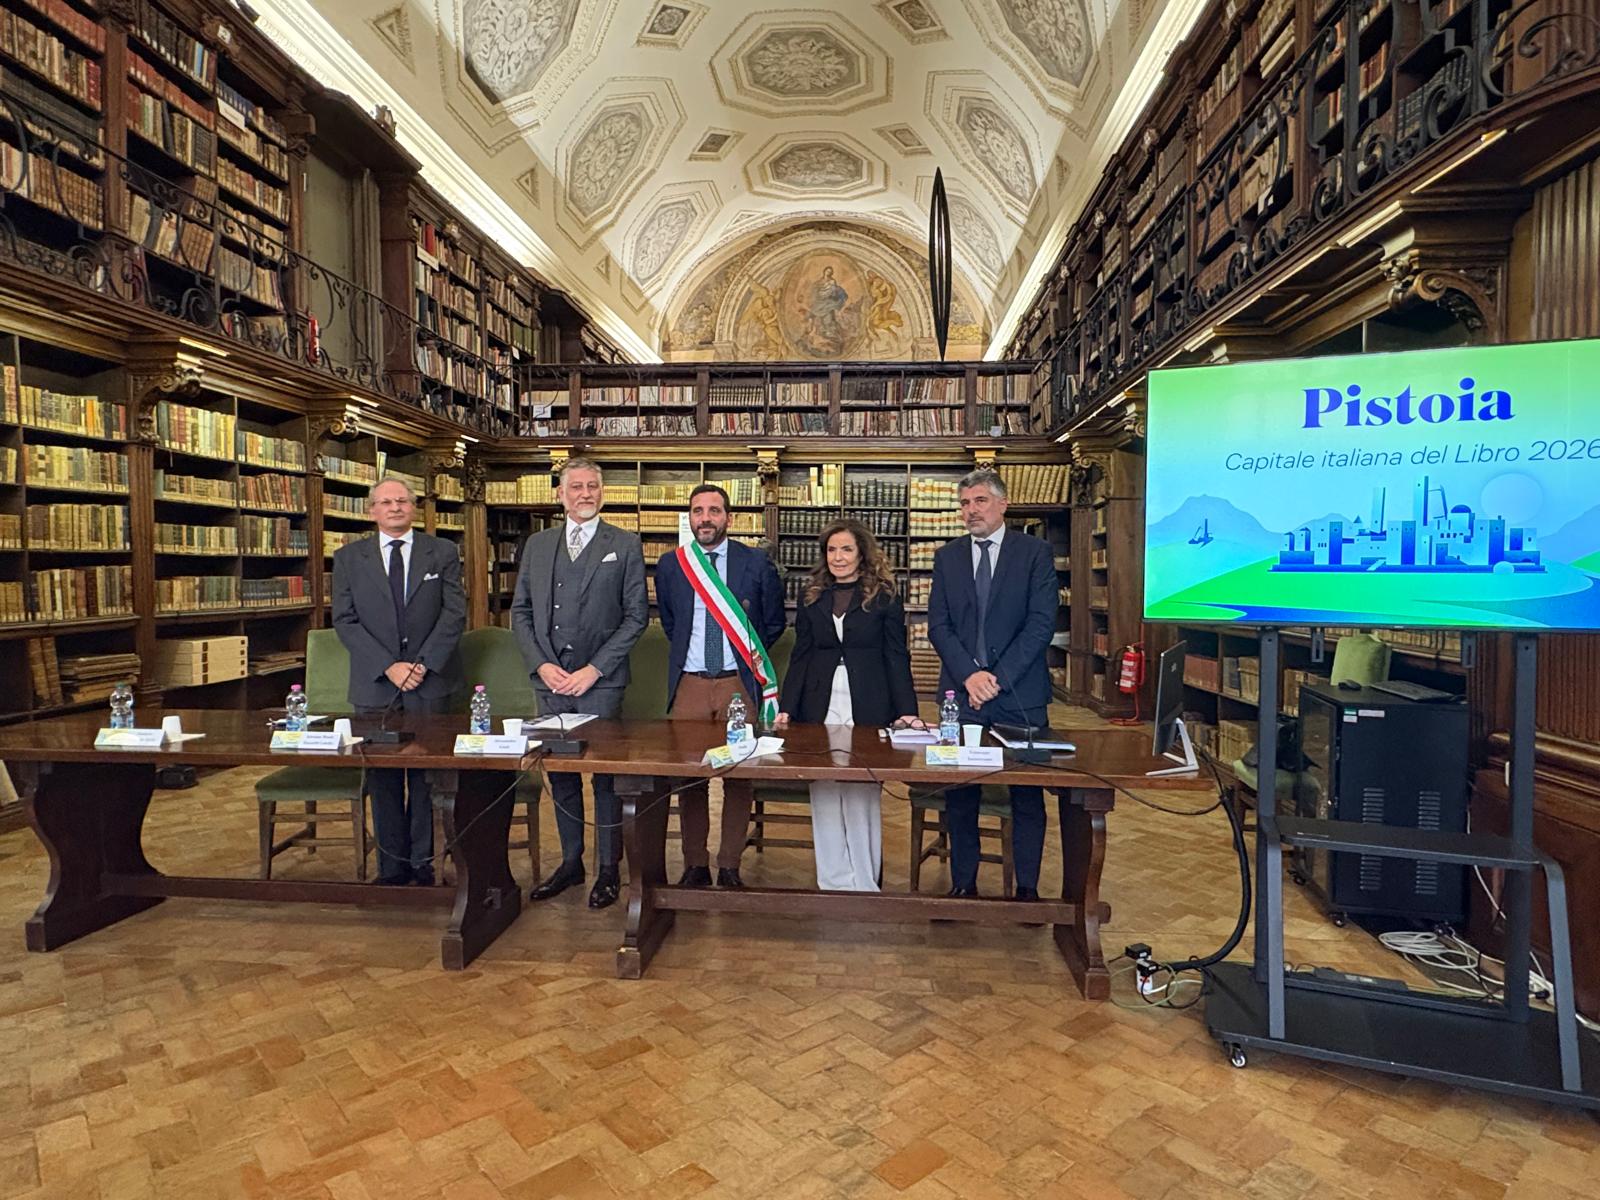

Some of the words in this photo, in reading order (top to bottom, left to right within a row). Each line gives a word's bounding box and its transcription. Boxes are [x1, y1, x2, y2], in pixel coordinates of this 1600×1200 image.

[1302, 377, 1515, 428] Pistoia
[1225, 450, 1315, 474] Capitale
[1321, 448, 1403, 468] italiana
[1410, 446, 1448, 465] del
[1454, 443, 1520, 463] Libro
[1528, 438, 1600, 461] 2026
